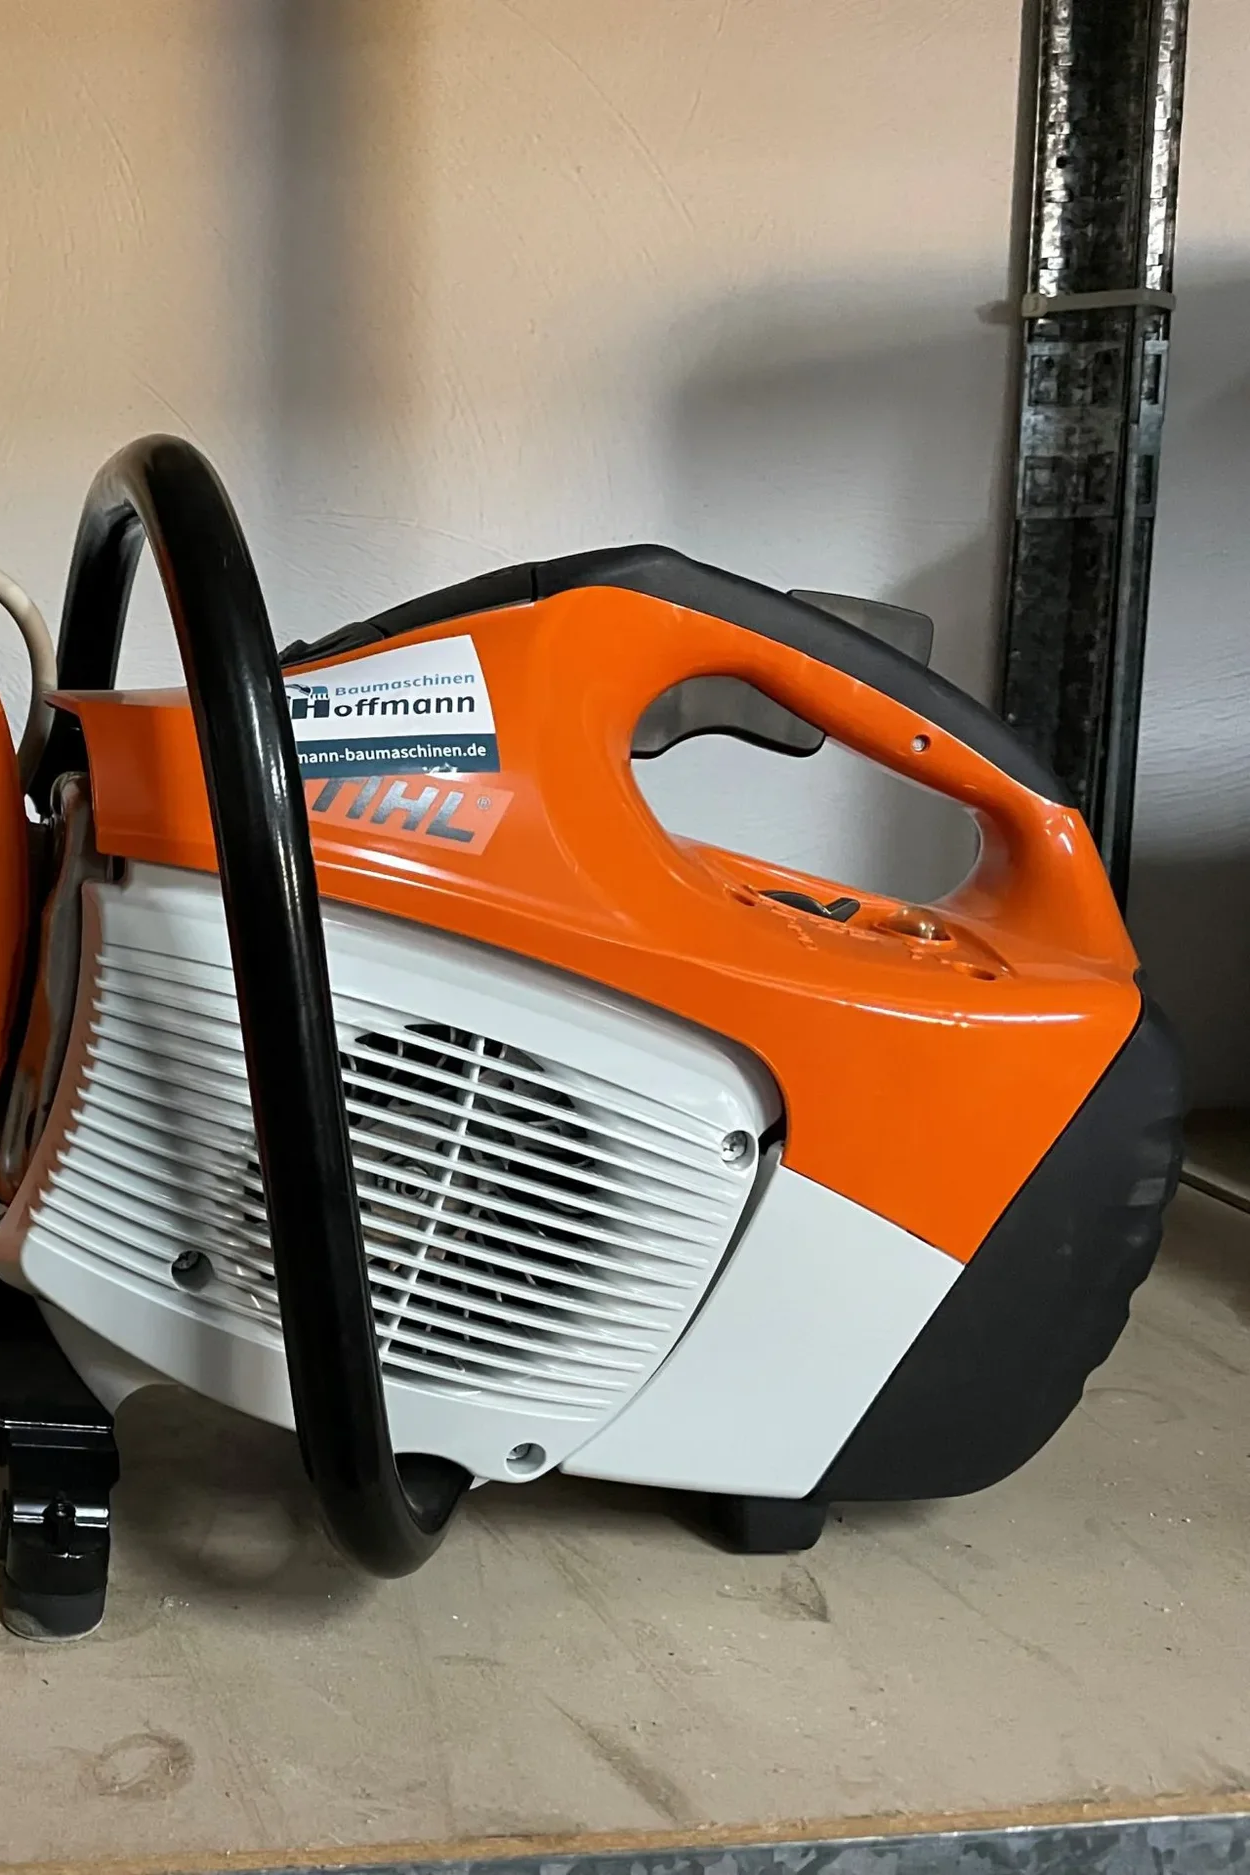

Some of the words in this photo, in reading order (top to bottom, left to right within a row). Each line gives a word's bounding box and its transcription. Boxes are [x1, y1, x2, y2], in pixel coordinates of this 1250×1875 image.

[335, 673, 476, 697] Baumaschinen
[291, 696, 475, 719] Hoffmann
[298, 743, 487, 764] mann-baumaschinen.de
[311, 776, 475, 843] TIHL
